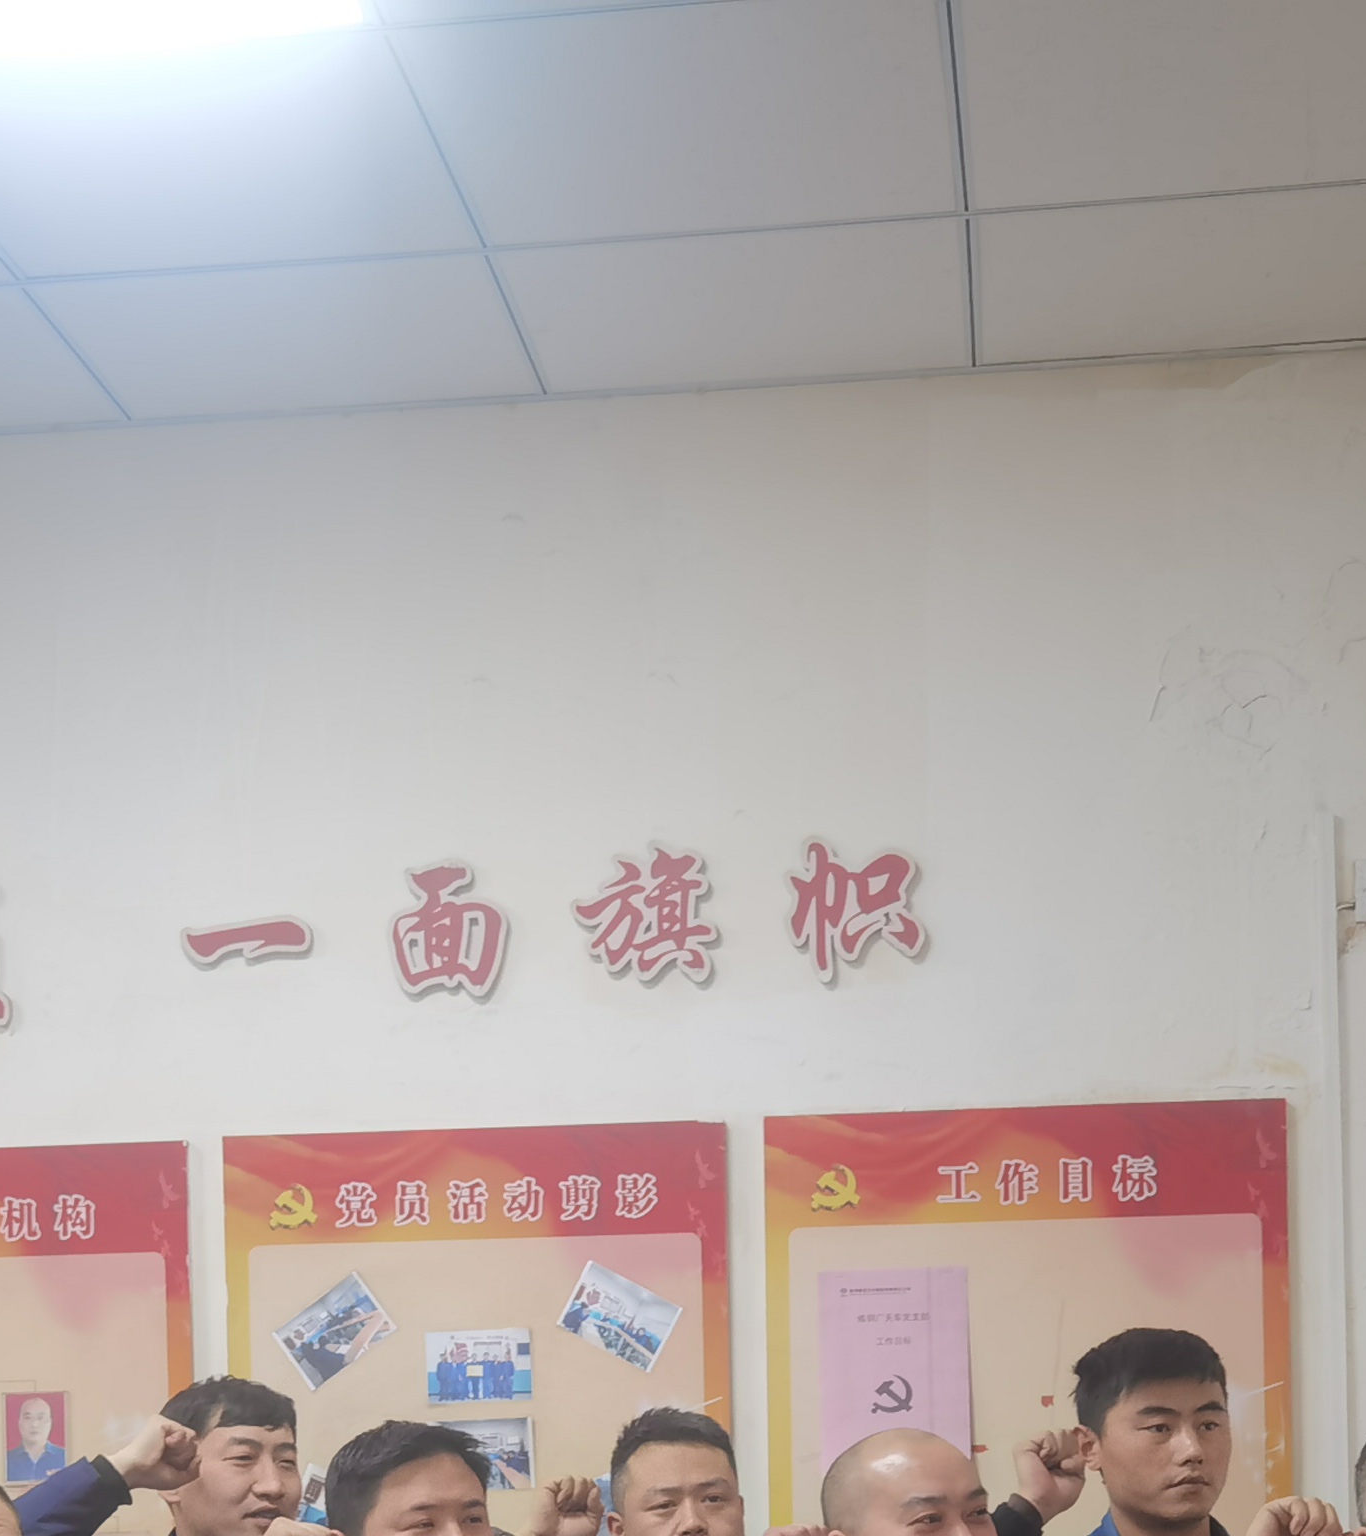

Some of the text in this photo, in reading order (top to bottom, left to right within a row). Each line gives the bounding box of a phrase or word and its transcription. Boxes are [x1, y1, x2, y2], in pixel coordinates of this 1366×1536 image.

[182, 839, 931, 998] 一面旗帜
[335, 1173, 658, 1228] 党员活动剪影
[937, 1154, 1158, 1206] 工作目标
